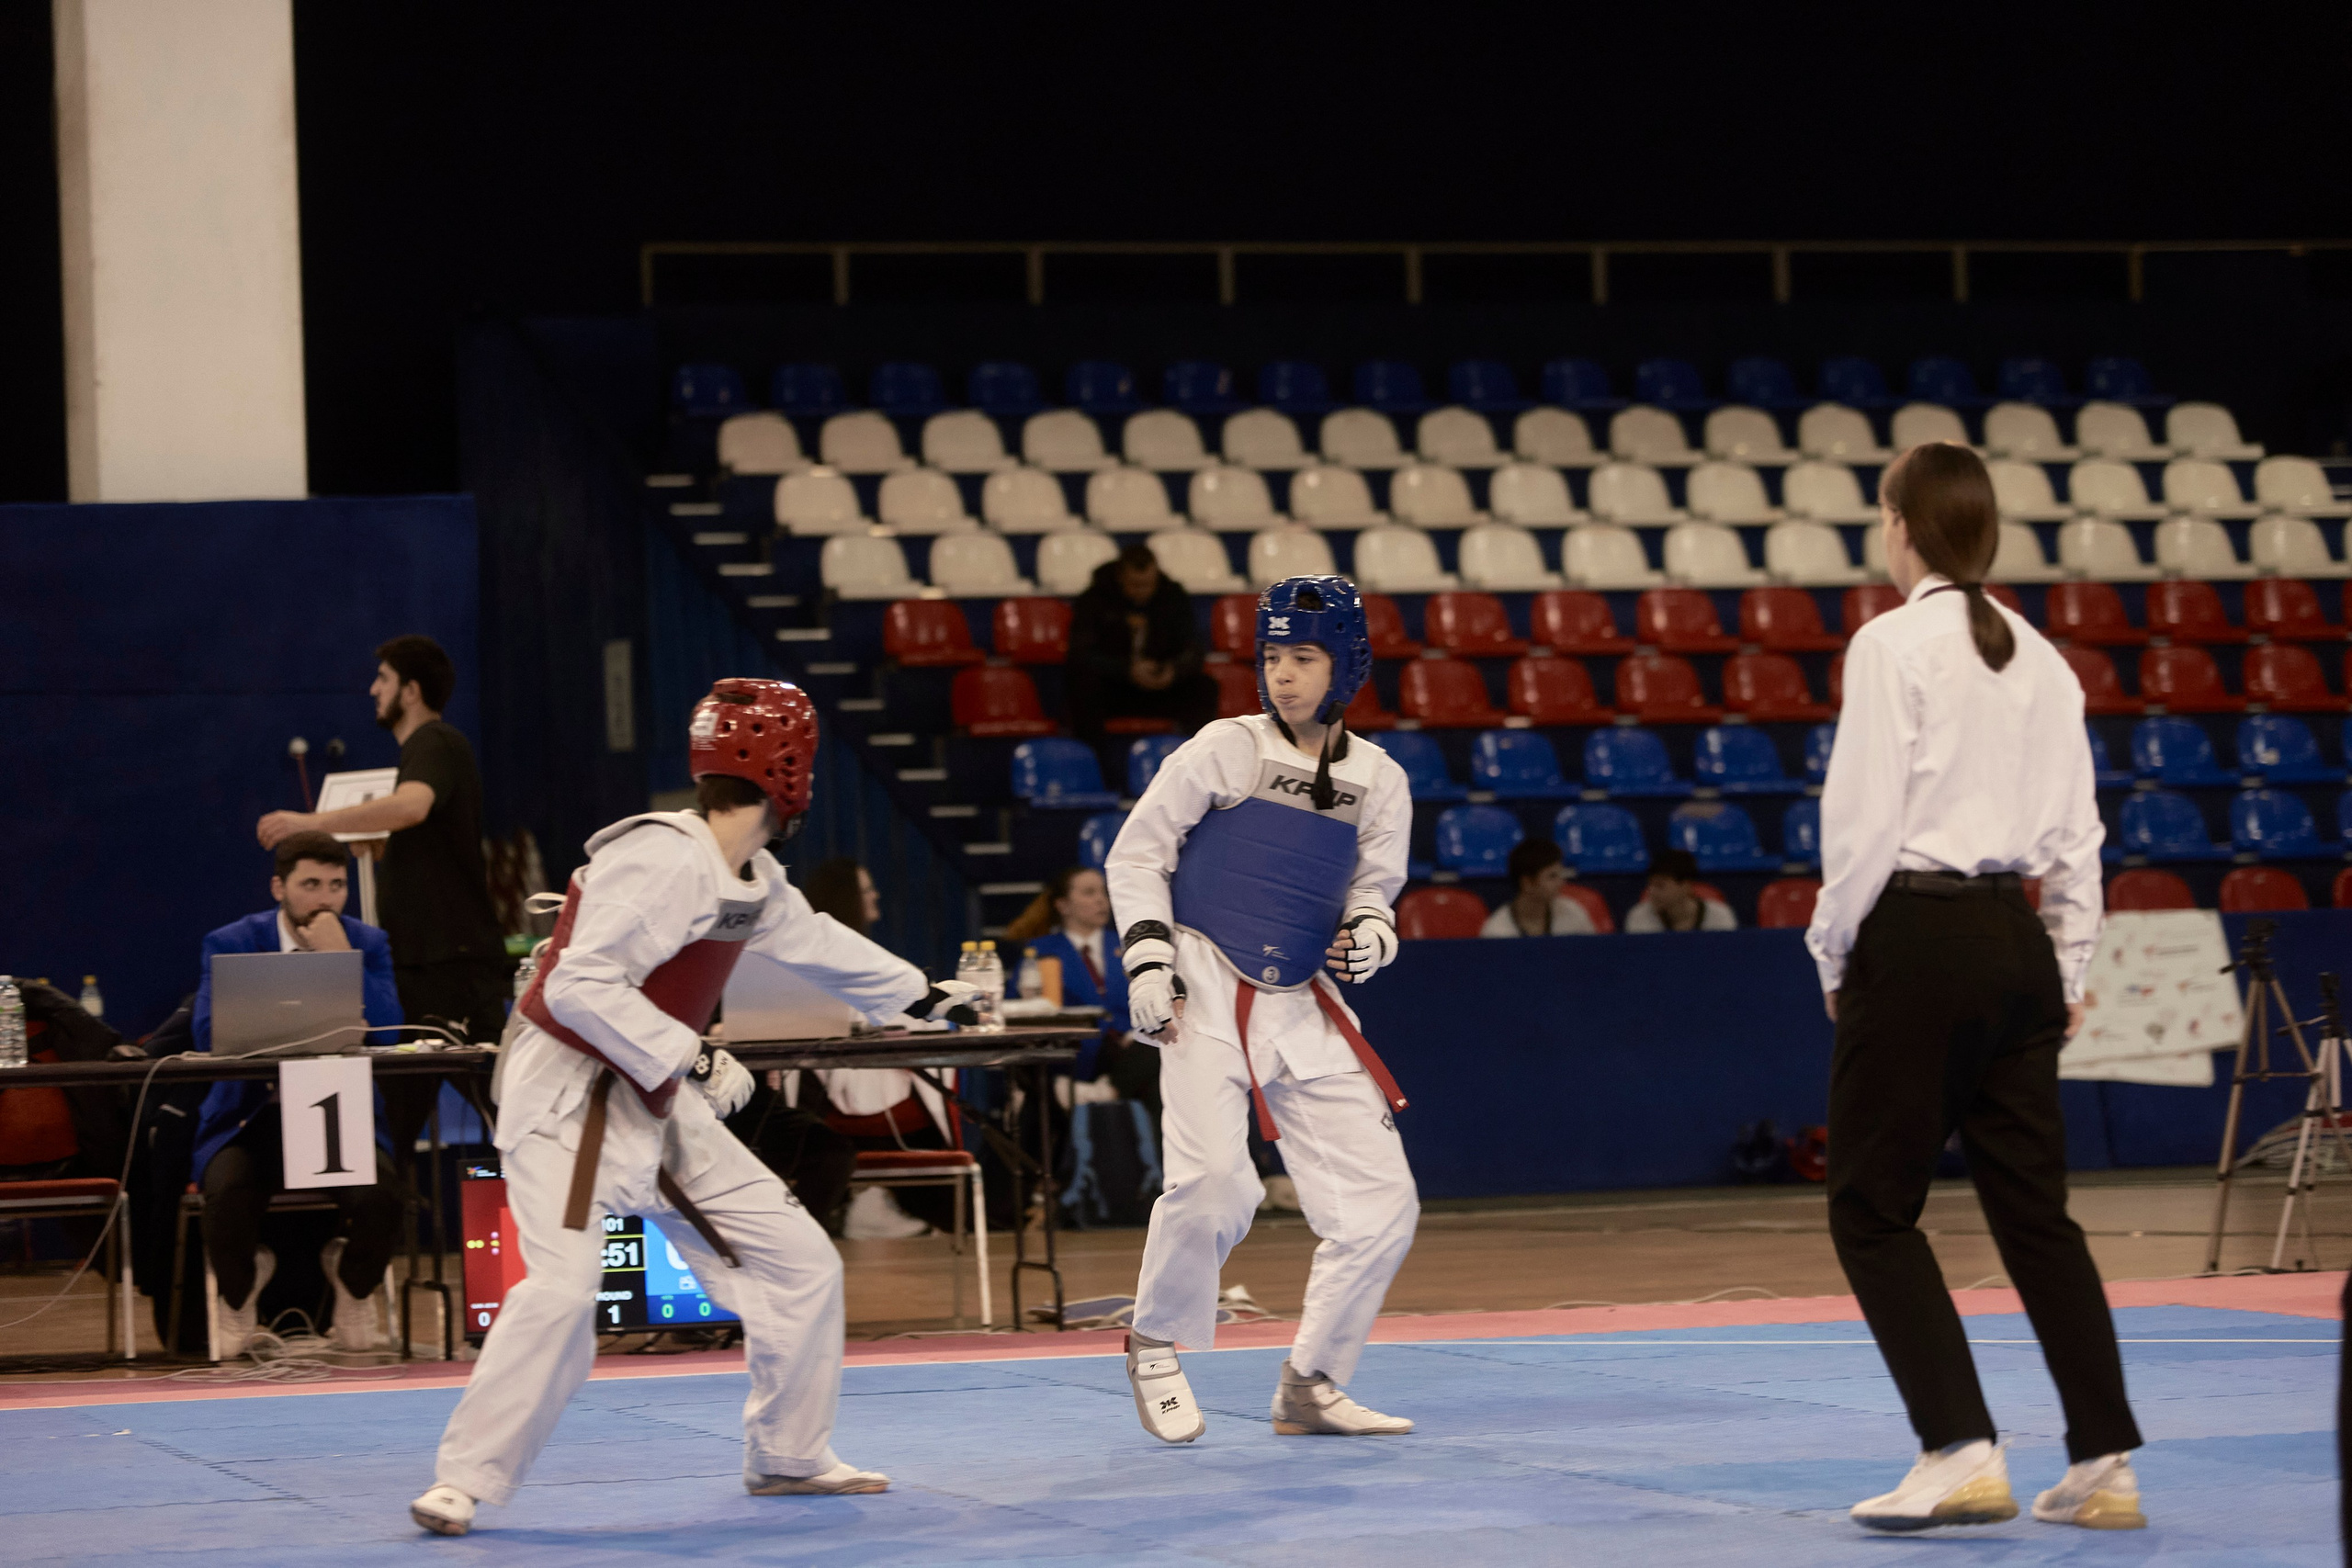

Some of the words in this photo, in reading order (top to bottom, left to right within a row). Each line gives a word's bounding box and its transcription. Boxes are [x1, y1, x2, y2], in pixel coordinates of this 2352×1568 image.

[309, 1092, 355, 1175] 1
[607, 1304, 620, 1324] 1
[662, 1303, 674, 1318] 0
[698, 1302, 711, 1316] 0
[478, 1312, 491, 1327] 0
